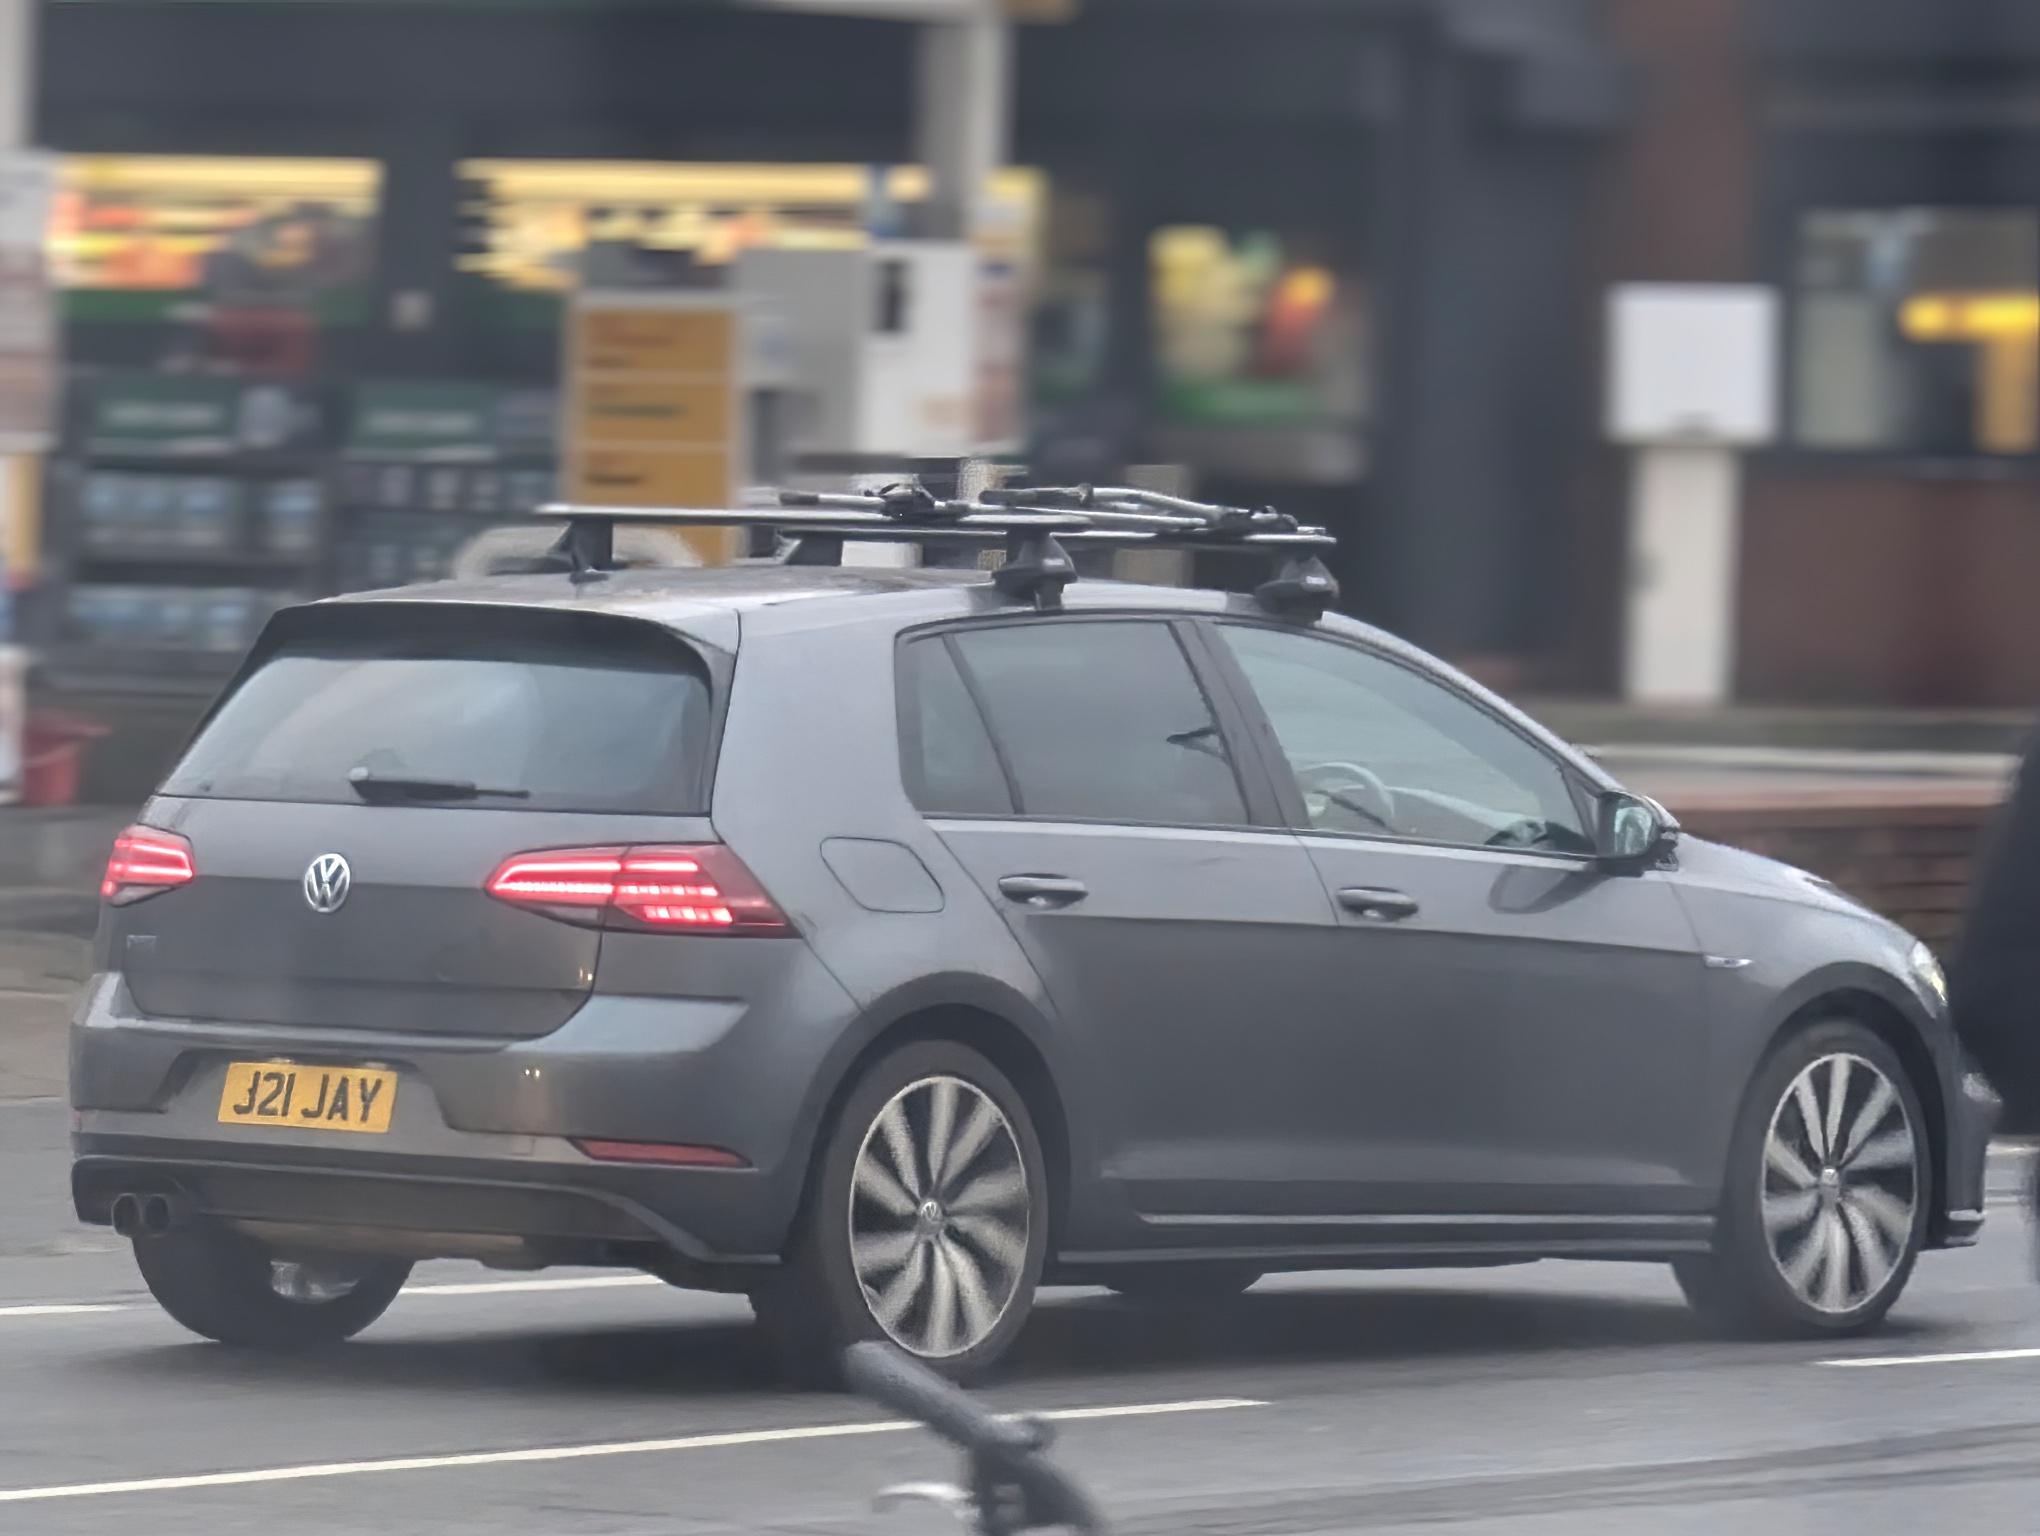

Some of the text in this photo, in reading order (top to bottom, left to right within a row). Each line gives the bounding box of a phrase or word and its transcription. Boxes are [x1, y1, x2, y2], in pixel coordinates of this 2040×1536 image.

[304, 853, 351, 913] VW
[233, 1071, 382, 1124] J21 JAY
